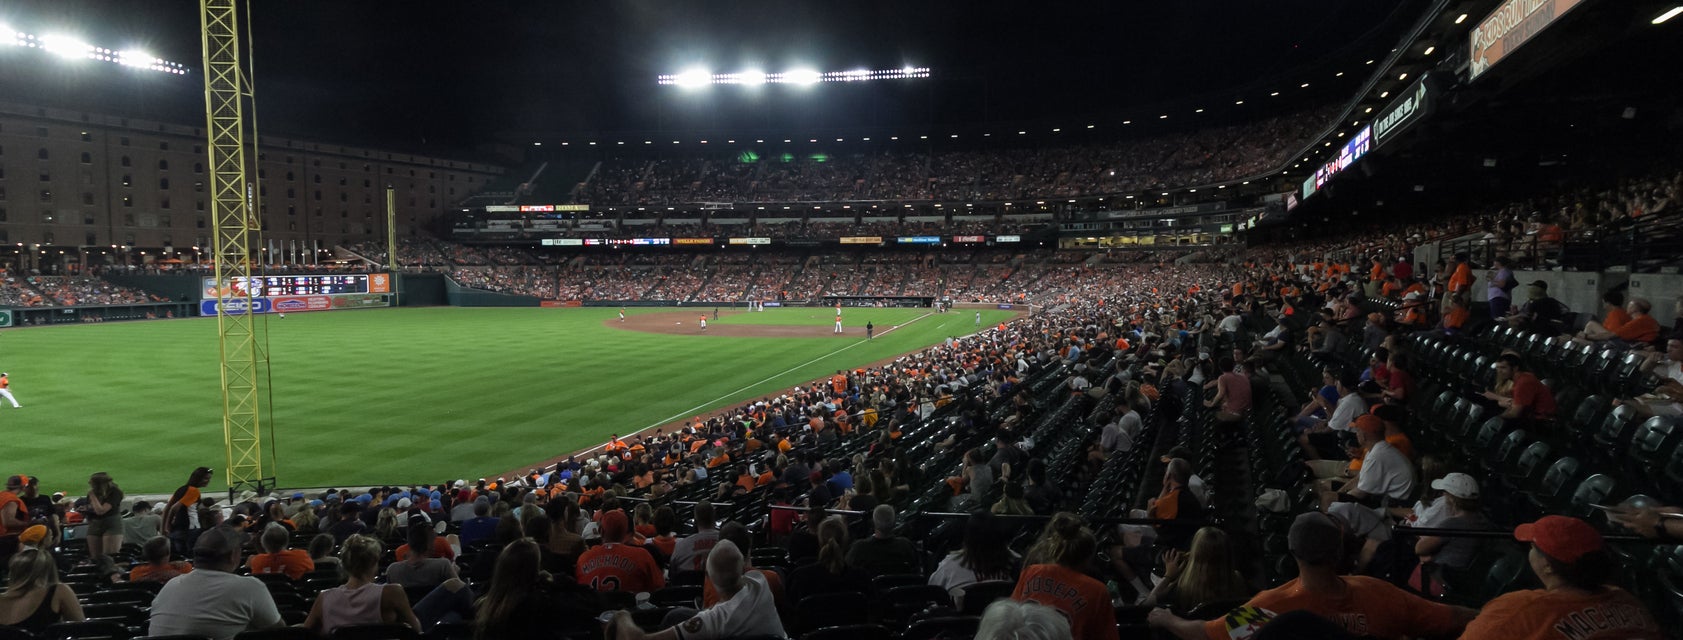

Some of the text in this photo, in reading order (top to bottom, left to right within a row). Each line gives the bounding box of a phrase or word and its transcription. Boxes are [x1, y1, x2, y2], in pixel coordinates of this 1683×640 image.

[1484, 12, 1503, 47] KIDS
[1503, 0, 1523, 34] RUN
[1023, 576, 1088, 613] JOSEPH
